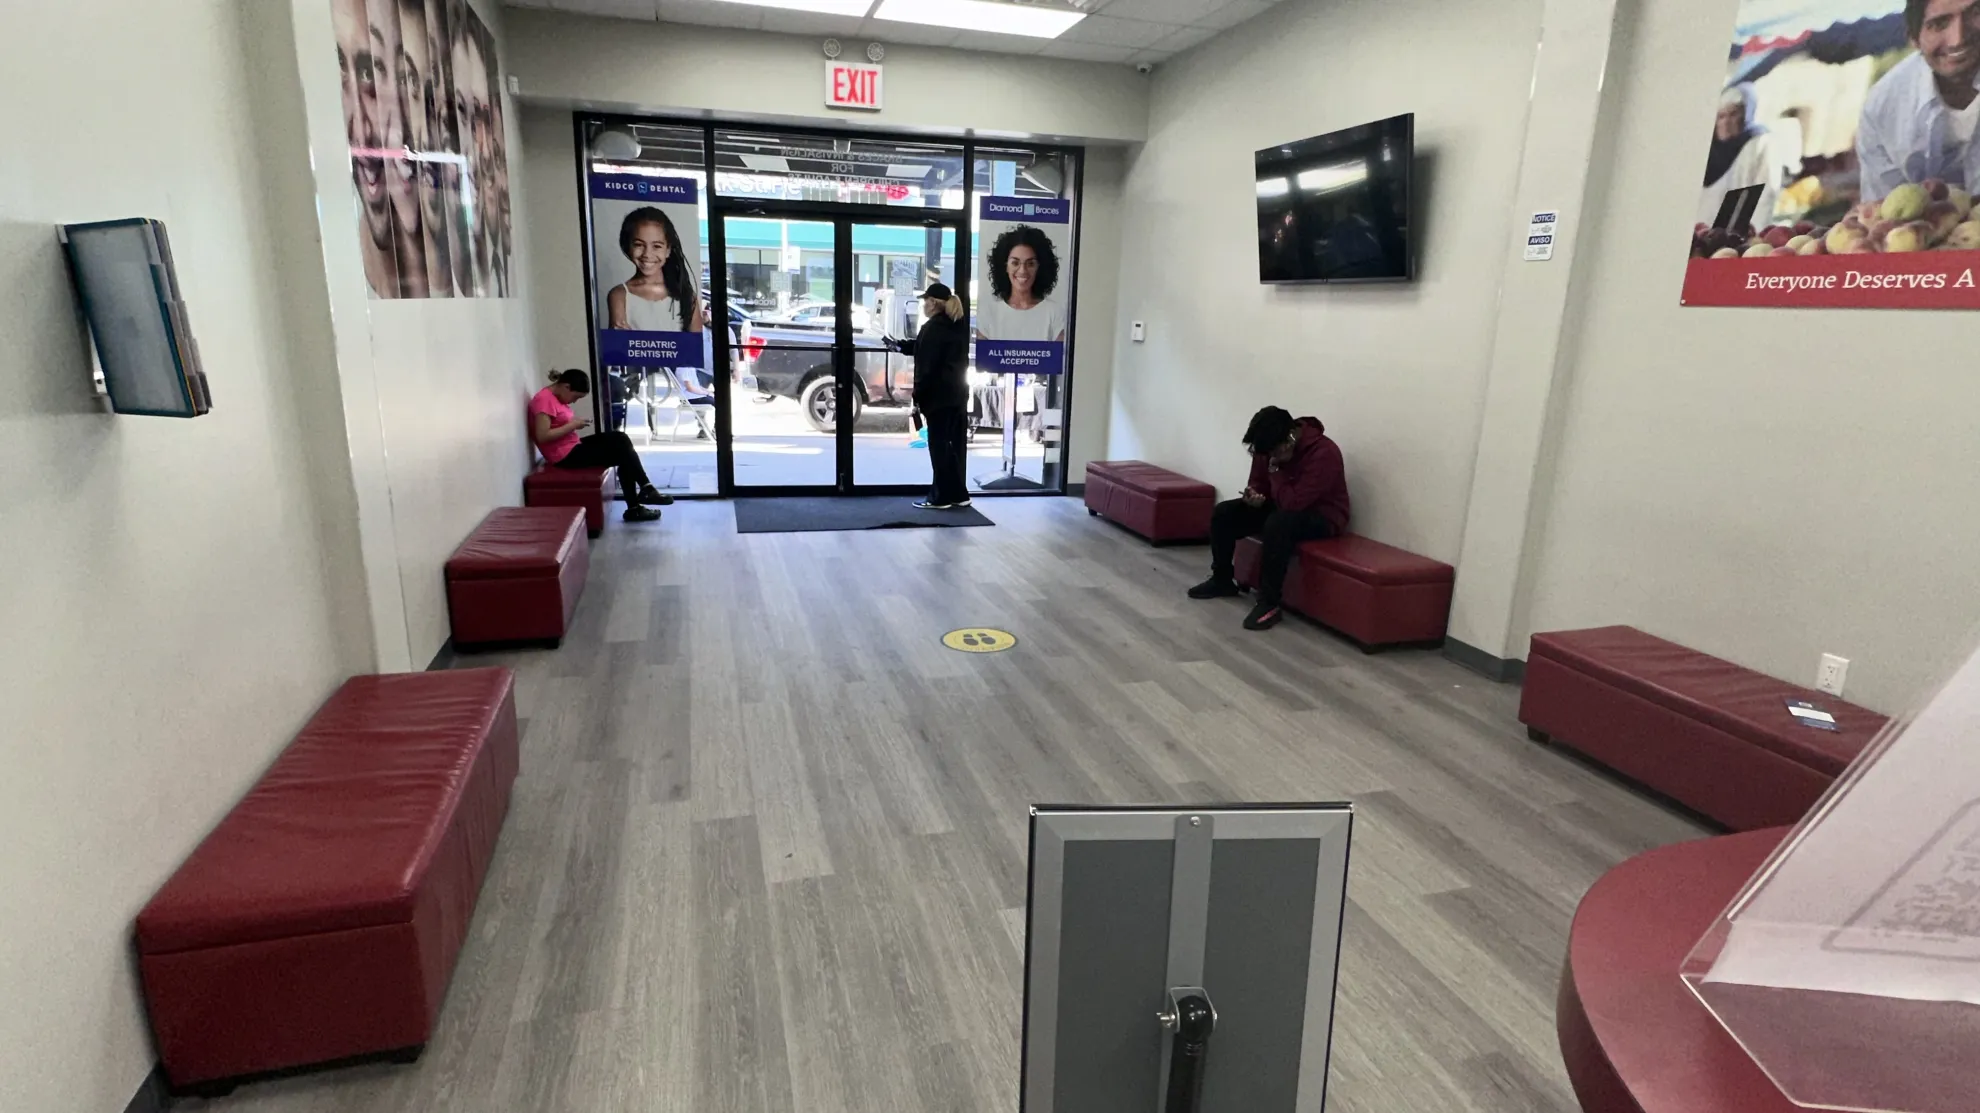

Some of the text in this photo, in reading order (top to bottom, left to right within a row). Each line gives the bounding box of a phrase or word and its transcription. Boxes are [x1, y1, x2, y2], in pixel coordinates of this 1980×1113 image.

[833, 67, 878, 105] EXIT
[605, 182, 686, 194] KIDCO DENTAL
[989, 203, 1060, 215] Diamond Braces
[1532, 214, 1556, 223] NOTICE
[1529, 236, 1550, 244] AVISO
[1745, 268, 1976, 293] Everyone Deserves A
[628, 340, 677, 349] PEDIATRIC
[628, 349, 678, 358] DENTISTRY
[988, 349, 1051, 358] ALL INSURANCES
[1000, 358, 1040, 366] ACCEPTED
